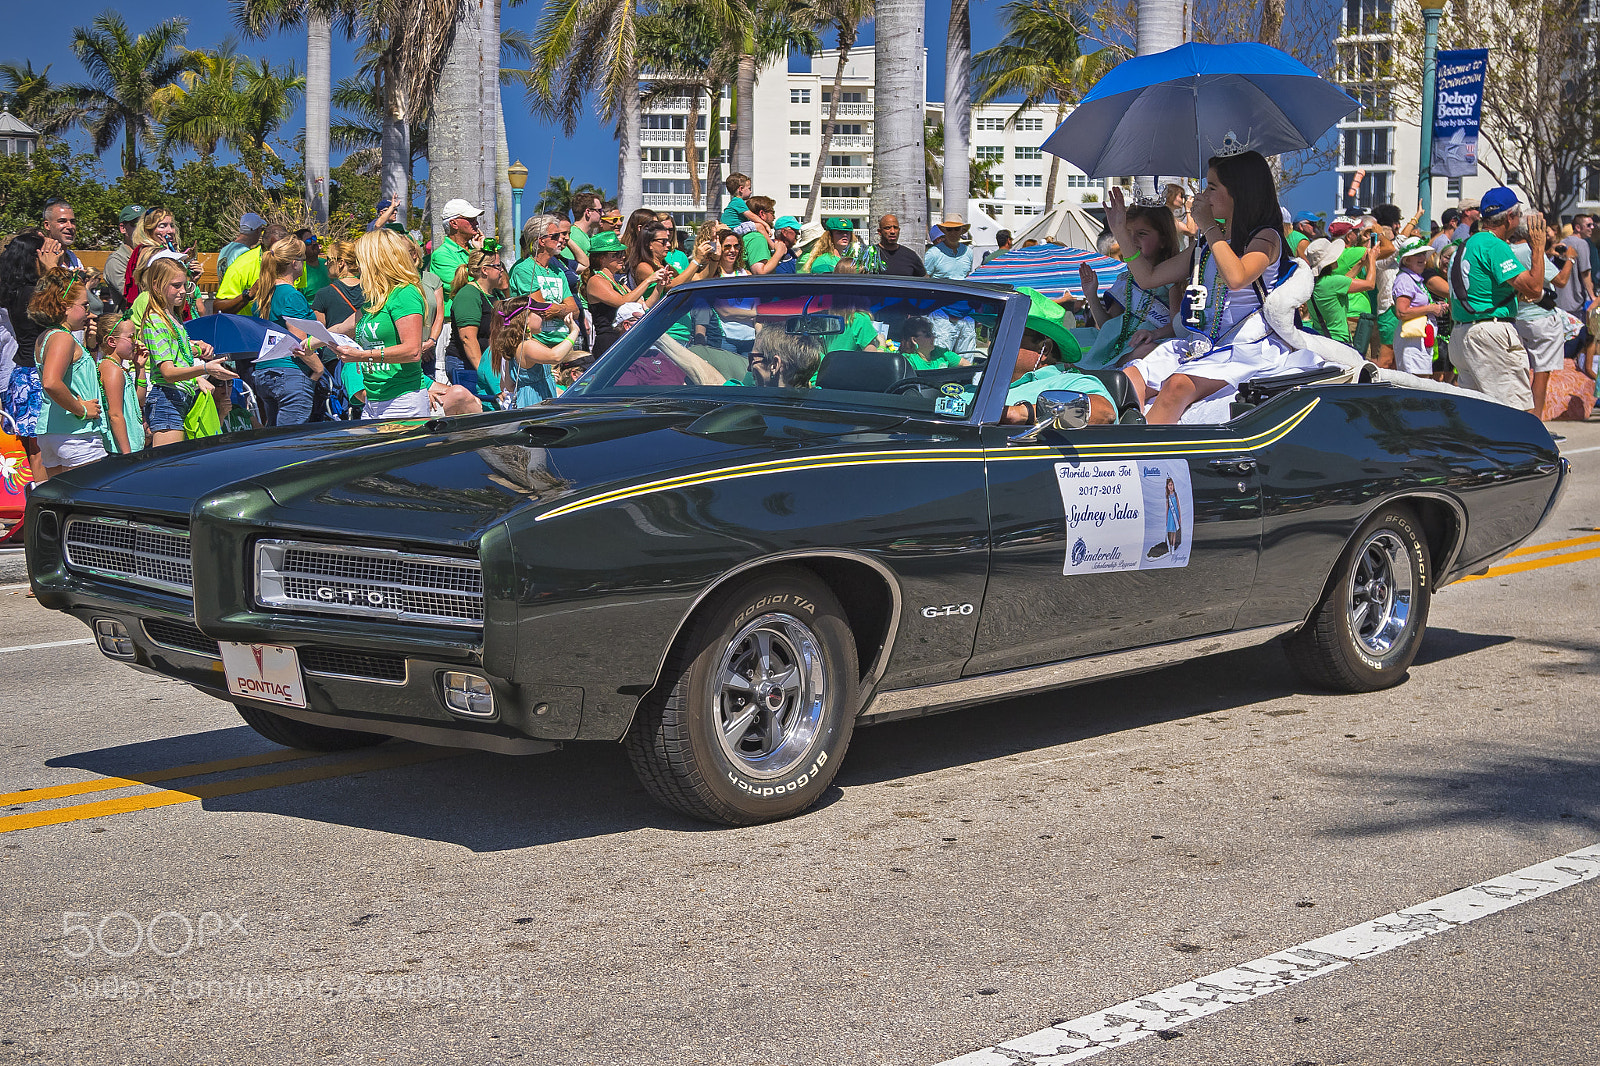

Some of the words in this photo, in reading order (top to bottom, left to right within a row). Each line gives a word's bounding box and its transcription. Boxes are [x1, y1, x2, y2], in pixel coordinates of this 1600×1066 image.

[1438, 91, 1477, 106] Delray
[1438, 104, 1473, 119] Beach
[1466, 118, 1478, 126] Sea
[1059, 466, 1091, 479] Florida
[1092, 466, 1116, 478] Queen
[1118, 465, 1132, 477] Tot
[1078, 484, 1122, 496] 2017-2018
[1066, 504, 1107, 528] Sydney
[1109, 503, 1139, 520] Salas
[1072, 543, 1121, 567] Cinderella
[317, 587, 383, 604] GTO
[734, 594, 789, 628] Radial
[793, 595, 815, 615] T/A
[920, 603, 974, 618] GTO
[237, 677, 293, 698] PONTIAC
[728, 750, 828, 797] BFGoodrich
